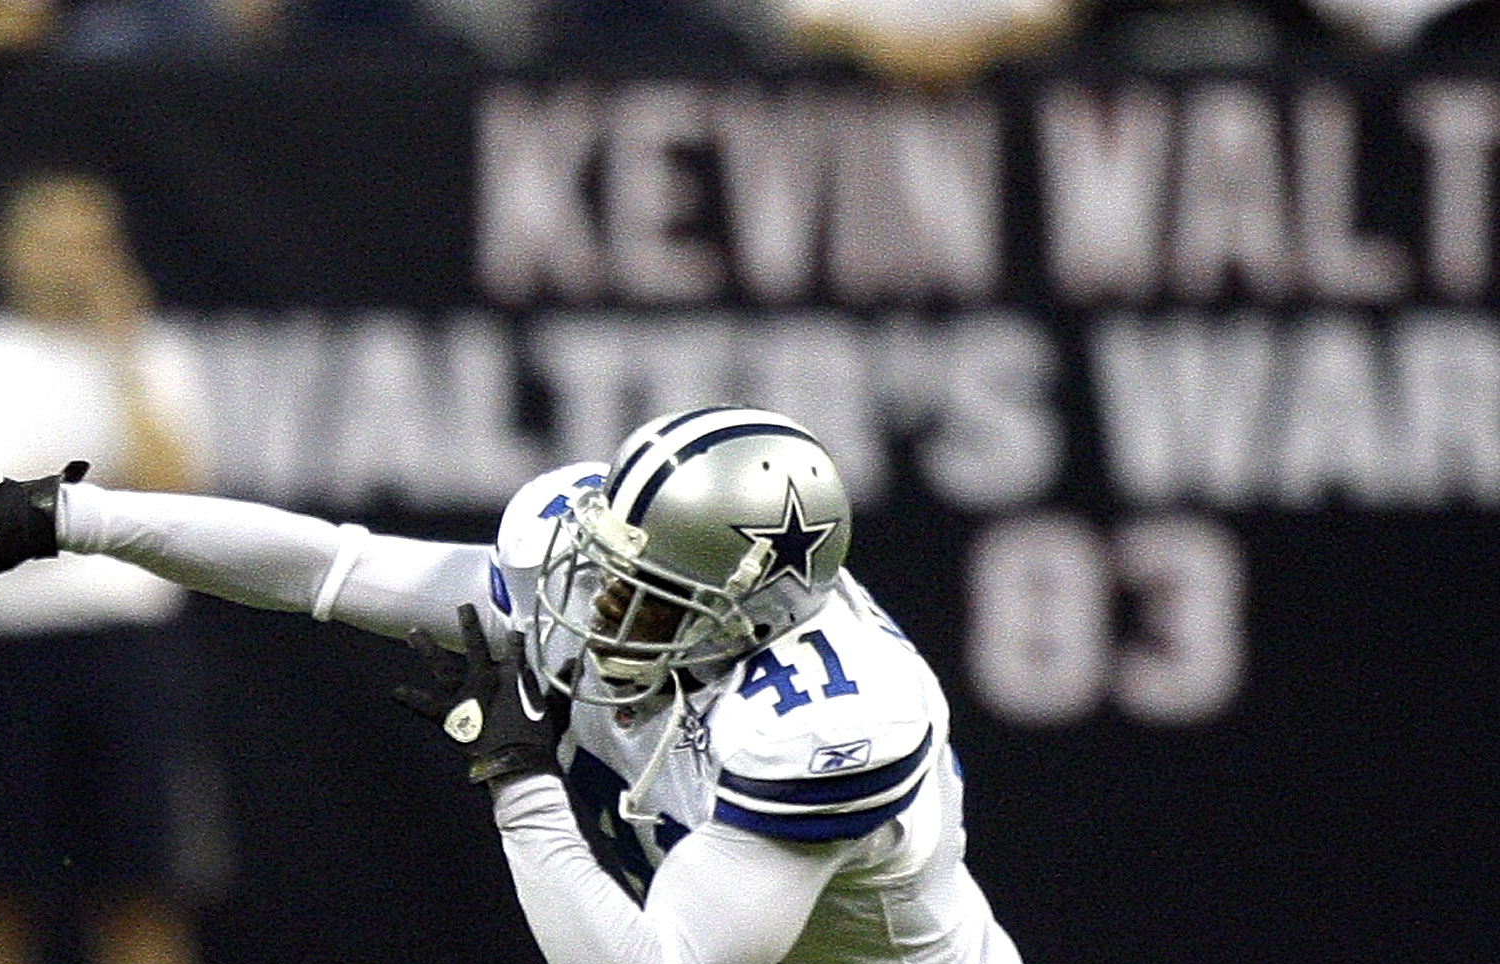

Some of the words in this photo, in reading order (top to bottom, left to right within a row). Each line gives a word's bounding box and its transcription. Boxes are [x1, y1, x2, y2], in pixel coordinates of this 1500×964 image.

[473, 80, 998, 300] KEVIN
[736, 629, 860, 717] 41
[968, 515, 1248, 725] 83
